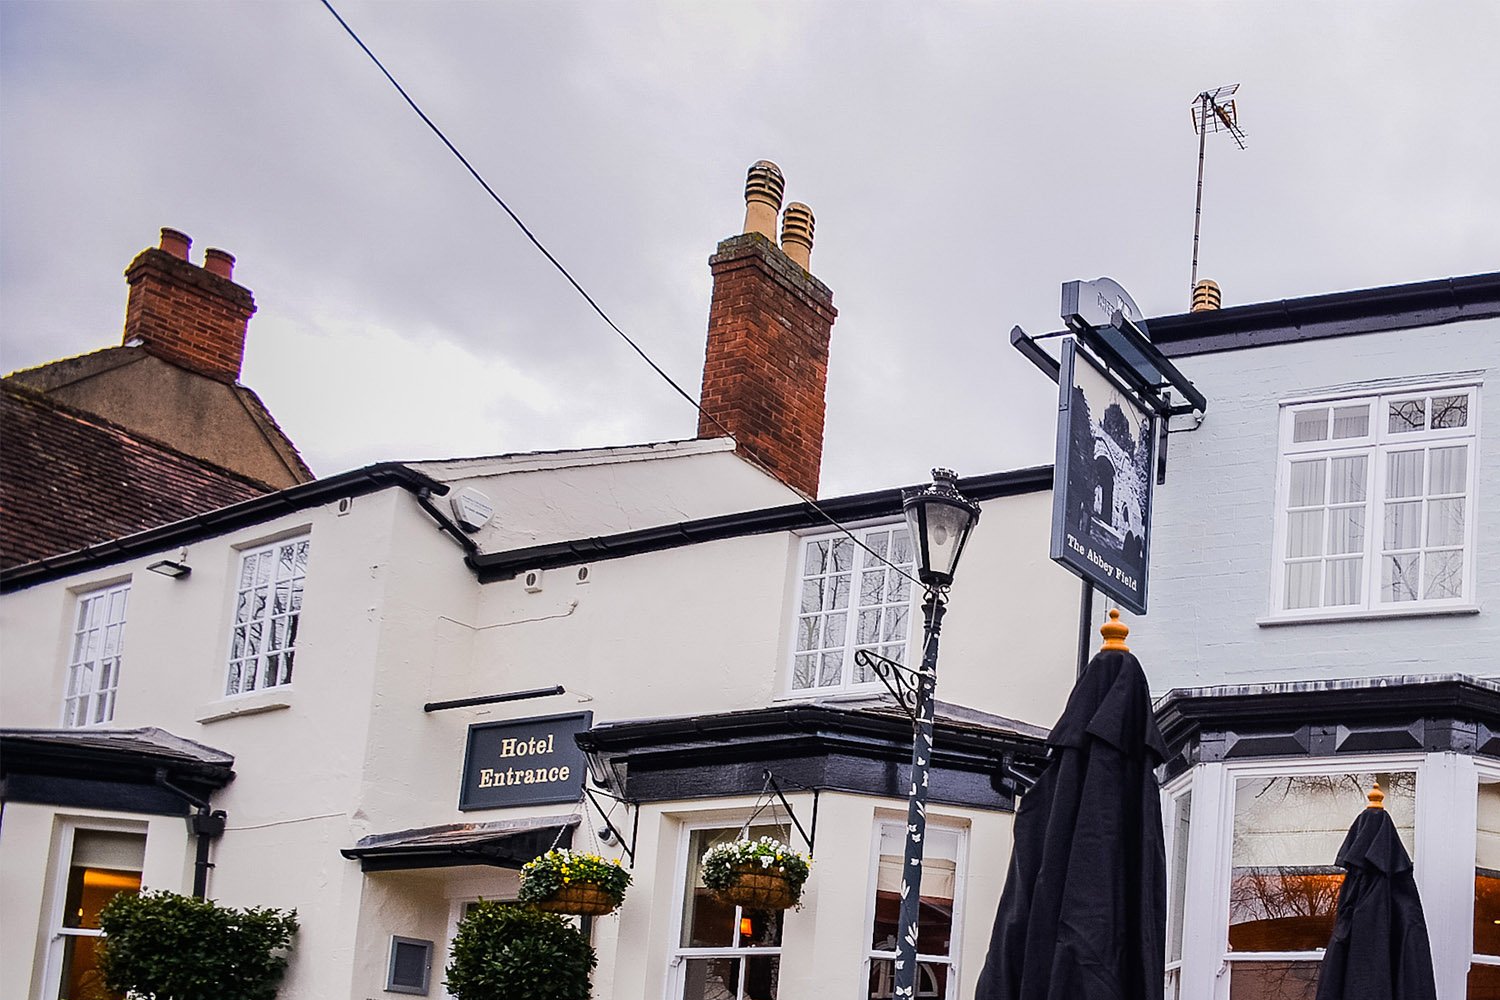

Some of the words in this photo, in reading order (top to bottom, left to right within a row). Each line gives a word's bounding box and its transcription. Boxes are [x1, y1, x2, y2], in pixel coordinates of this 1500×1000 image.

[1067, 534, 1084, 555] The
[1086, 548, 1114, 576] Abbey
[1115, 568, 1137, 592] Field
[500, 734, 554, 758] Hotel
[479, 766, 570, 788] Entrance
